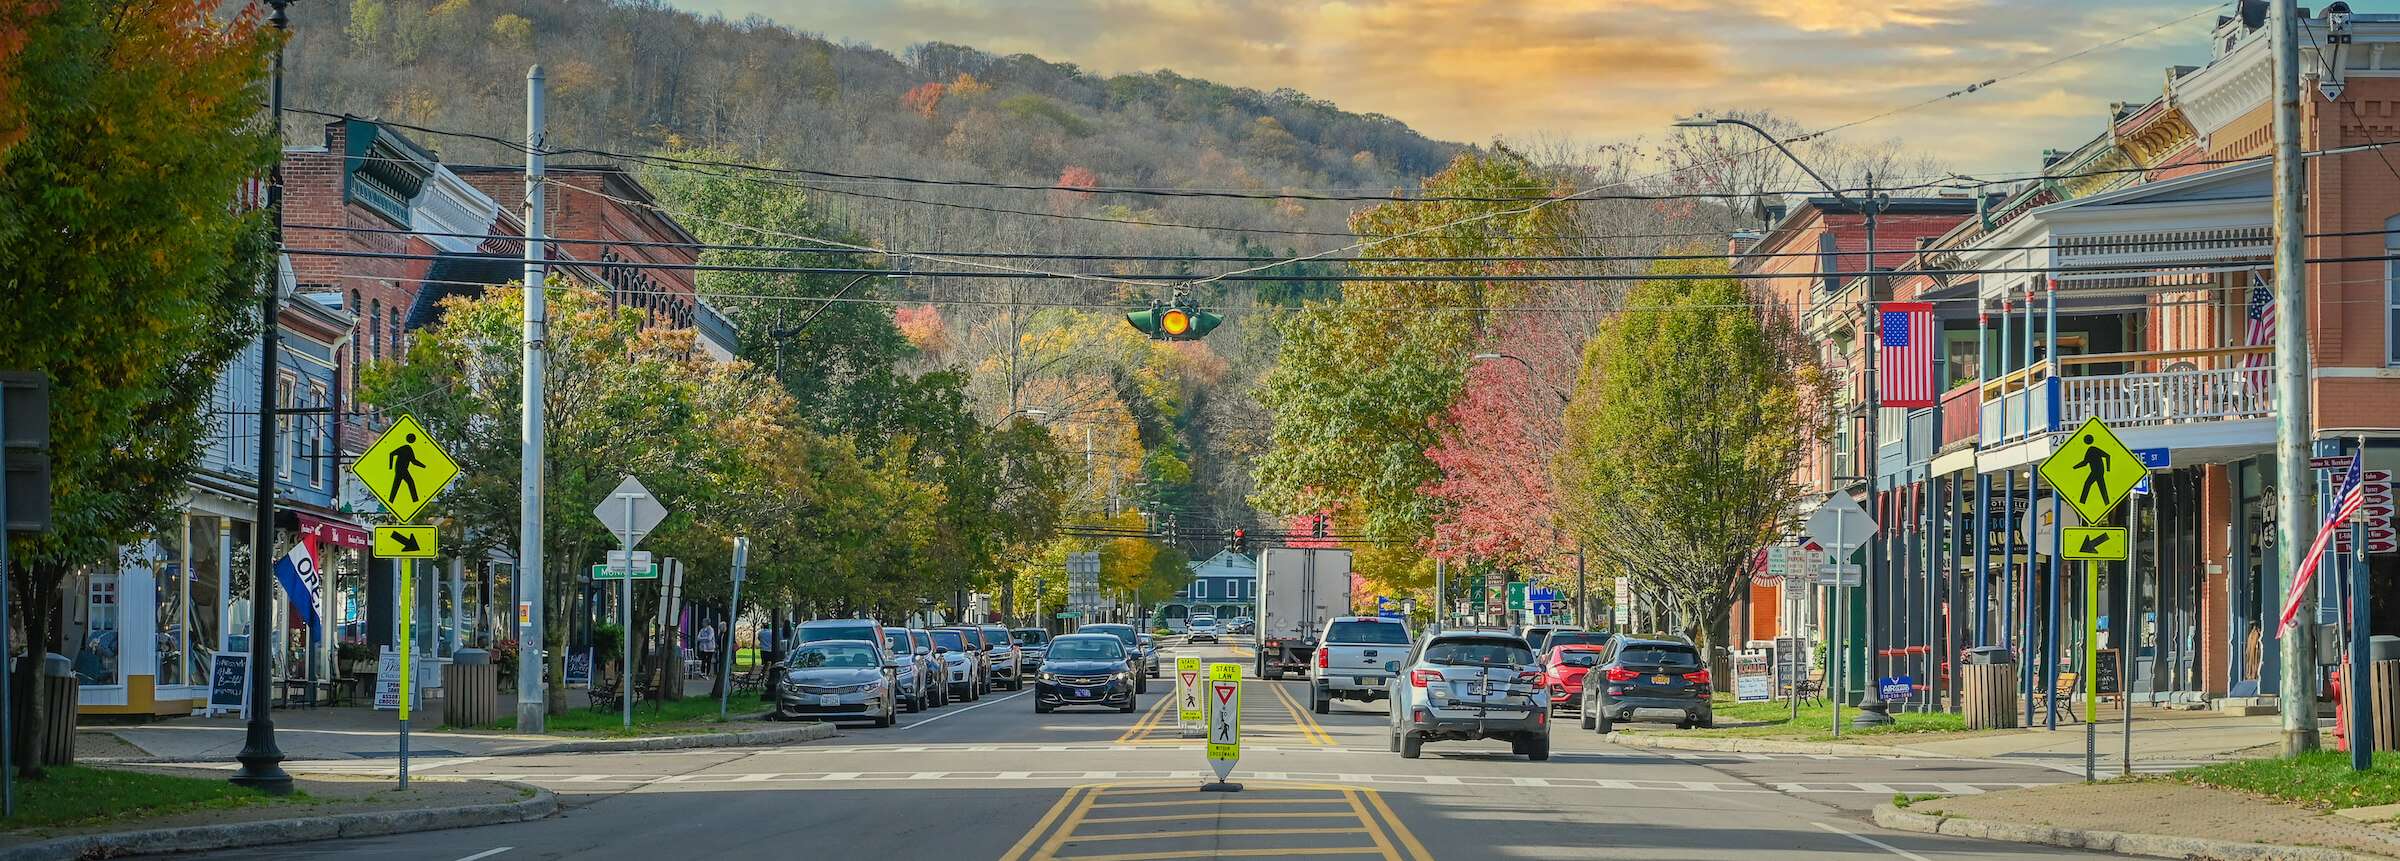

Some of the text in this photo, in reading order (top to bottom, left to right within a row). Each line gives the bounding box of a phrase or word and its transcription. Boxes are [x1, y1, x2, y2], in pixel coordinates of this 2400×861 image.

[2150, 453, 2159, 461] ST
[298, 557, 320, 608] OPE
[1215, 665, 1236, 673] STATE
